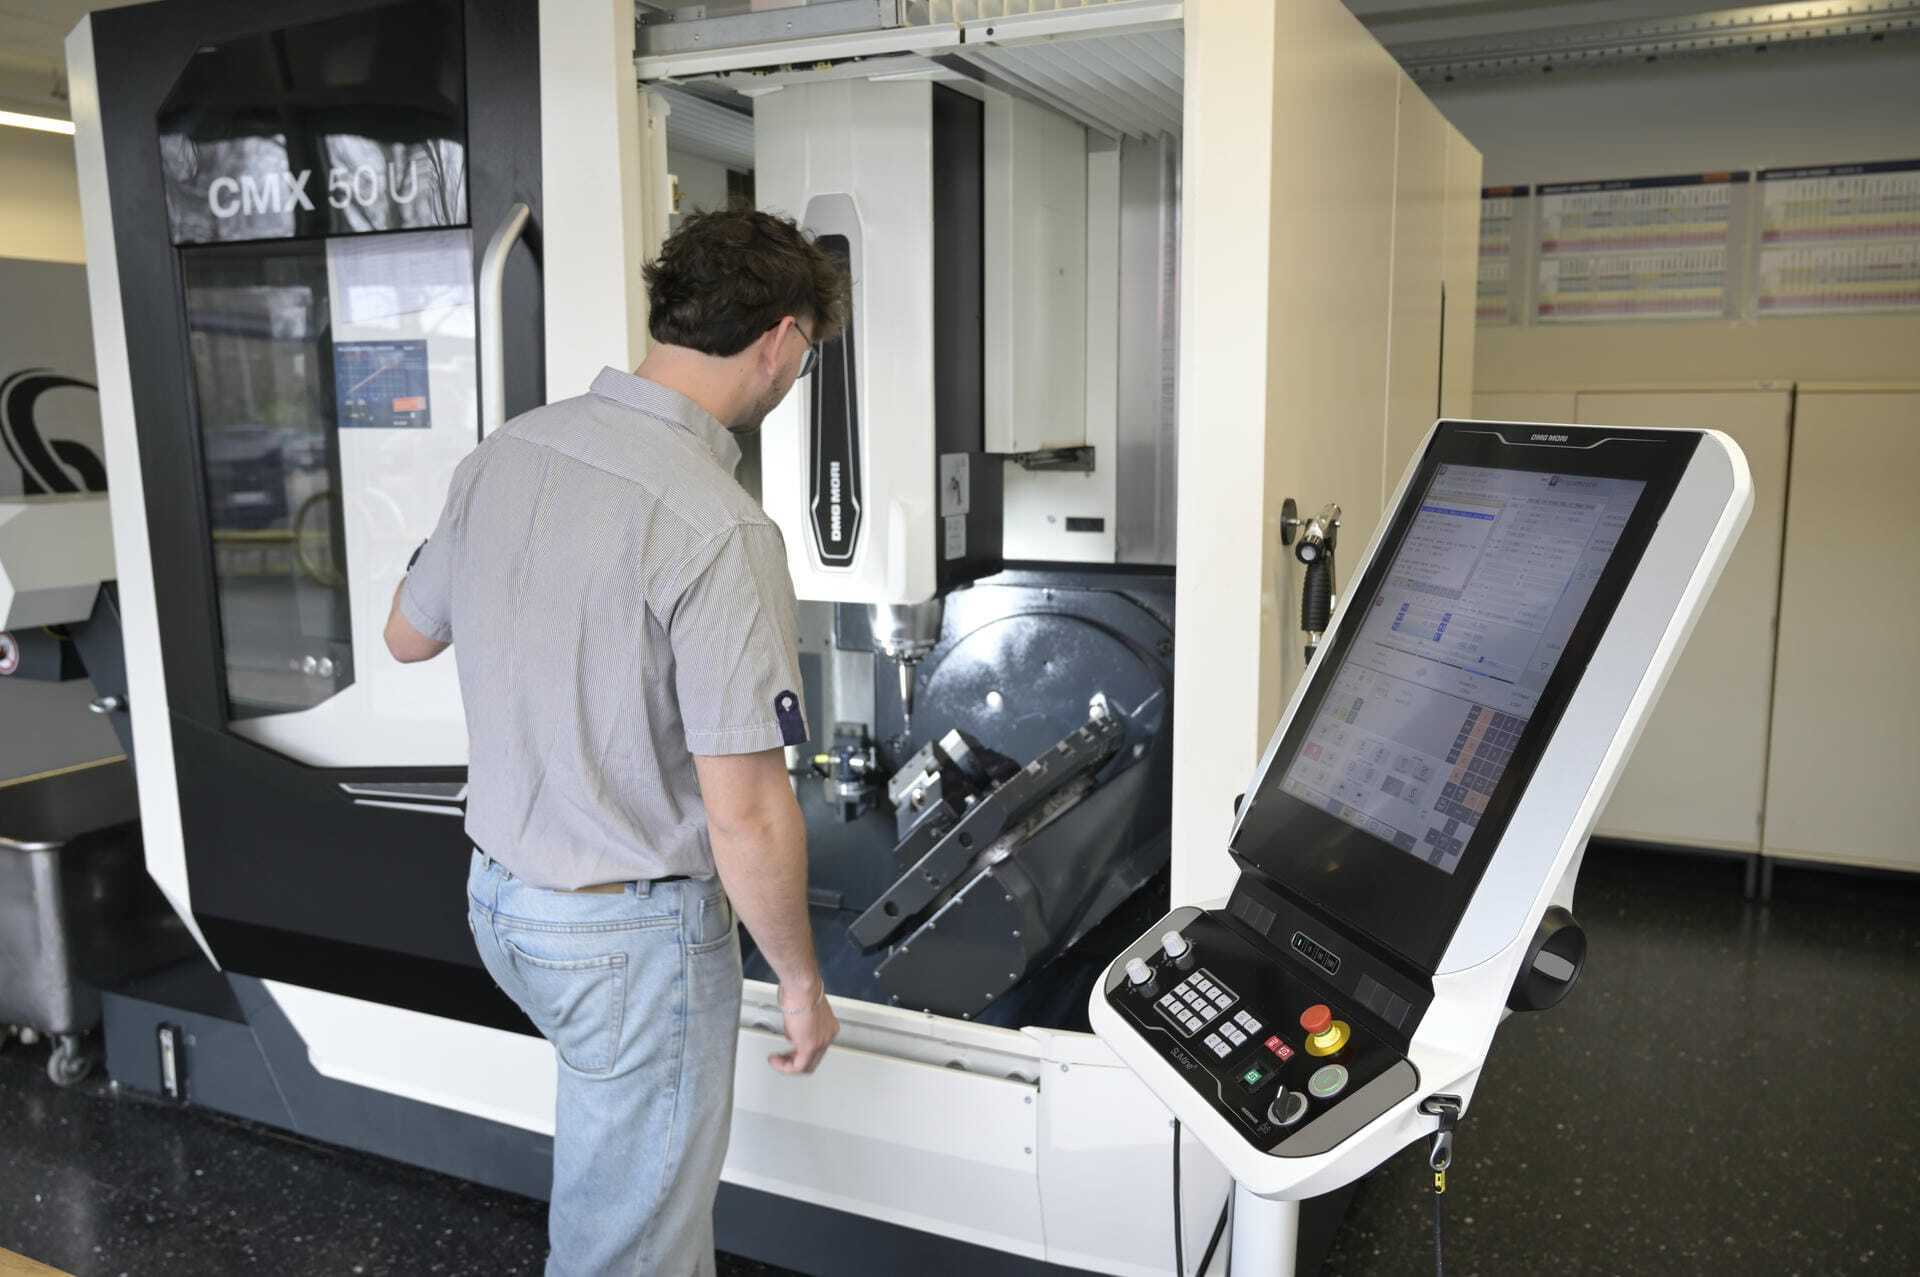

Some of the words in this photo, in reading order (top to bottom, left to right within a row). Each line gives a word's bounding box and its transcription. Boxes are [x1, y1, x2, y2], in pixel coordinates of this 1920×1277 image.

[208, 169, 316, 218] CMX
[328, 165, 378, 209] 50
[388, 160, 418, 204] U
[830, 461, 840, 503] MORI
[831, 503, 841, 541] DMG
